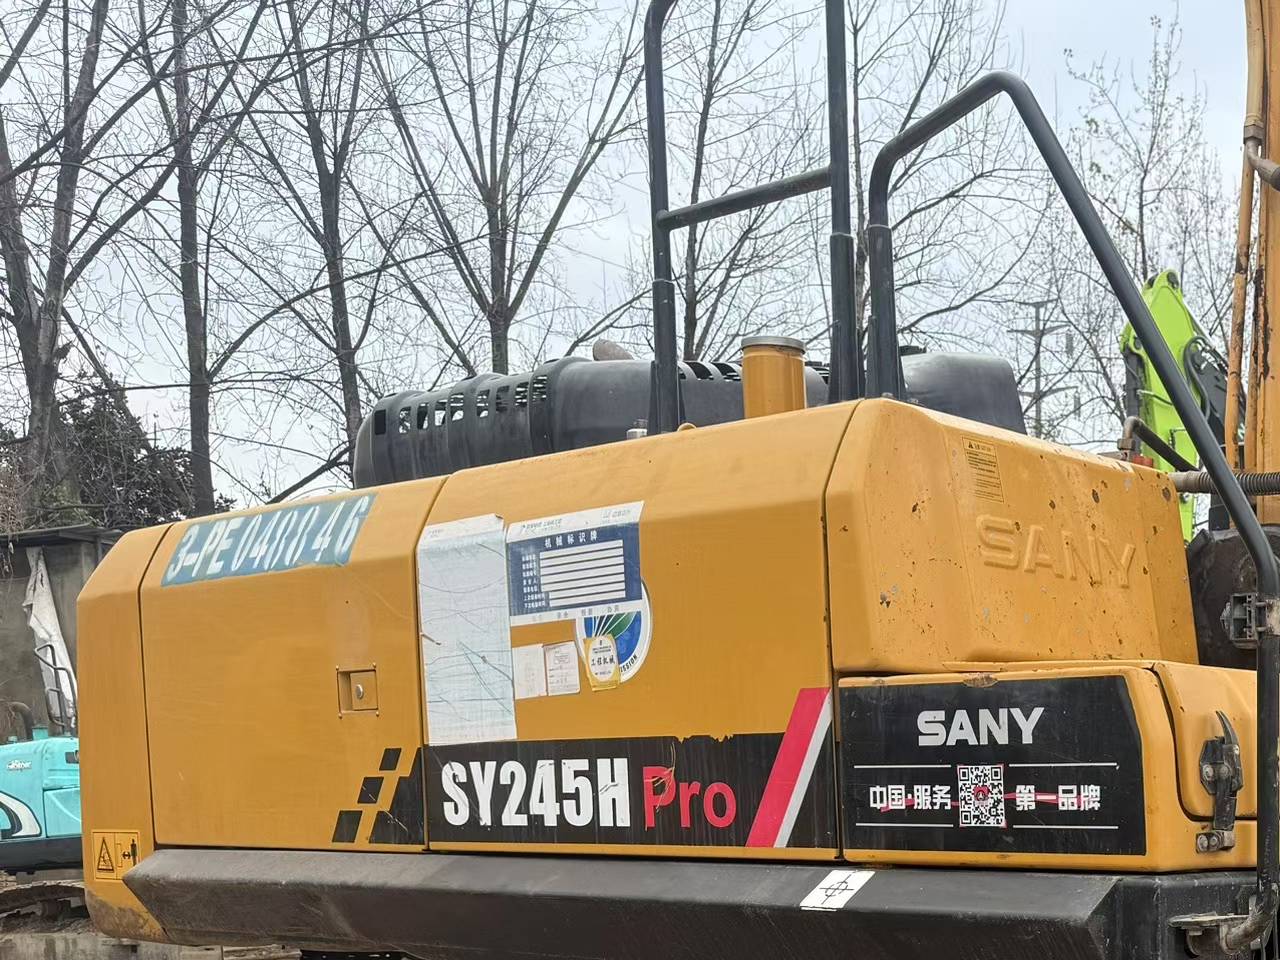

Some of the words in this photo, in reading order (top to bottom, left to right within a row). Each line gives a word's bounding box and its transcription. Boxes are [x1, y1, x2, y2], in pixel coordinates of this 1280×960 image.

[975, 514, 1137, 589] SANY
[916, 707, 1045, 747] SANY
[441, 757, 631, 827] SY245H
[642, 766, 737, 830] Pro
[869, 784, 952, 811] 中国·服务
[1014, 784, 1101, 811] 第一品牌
